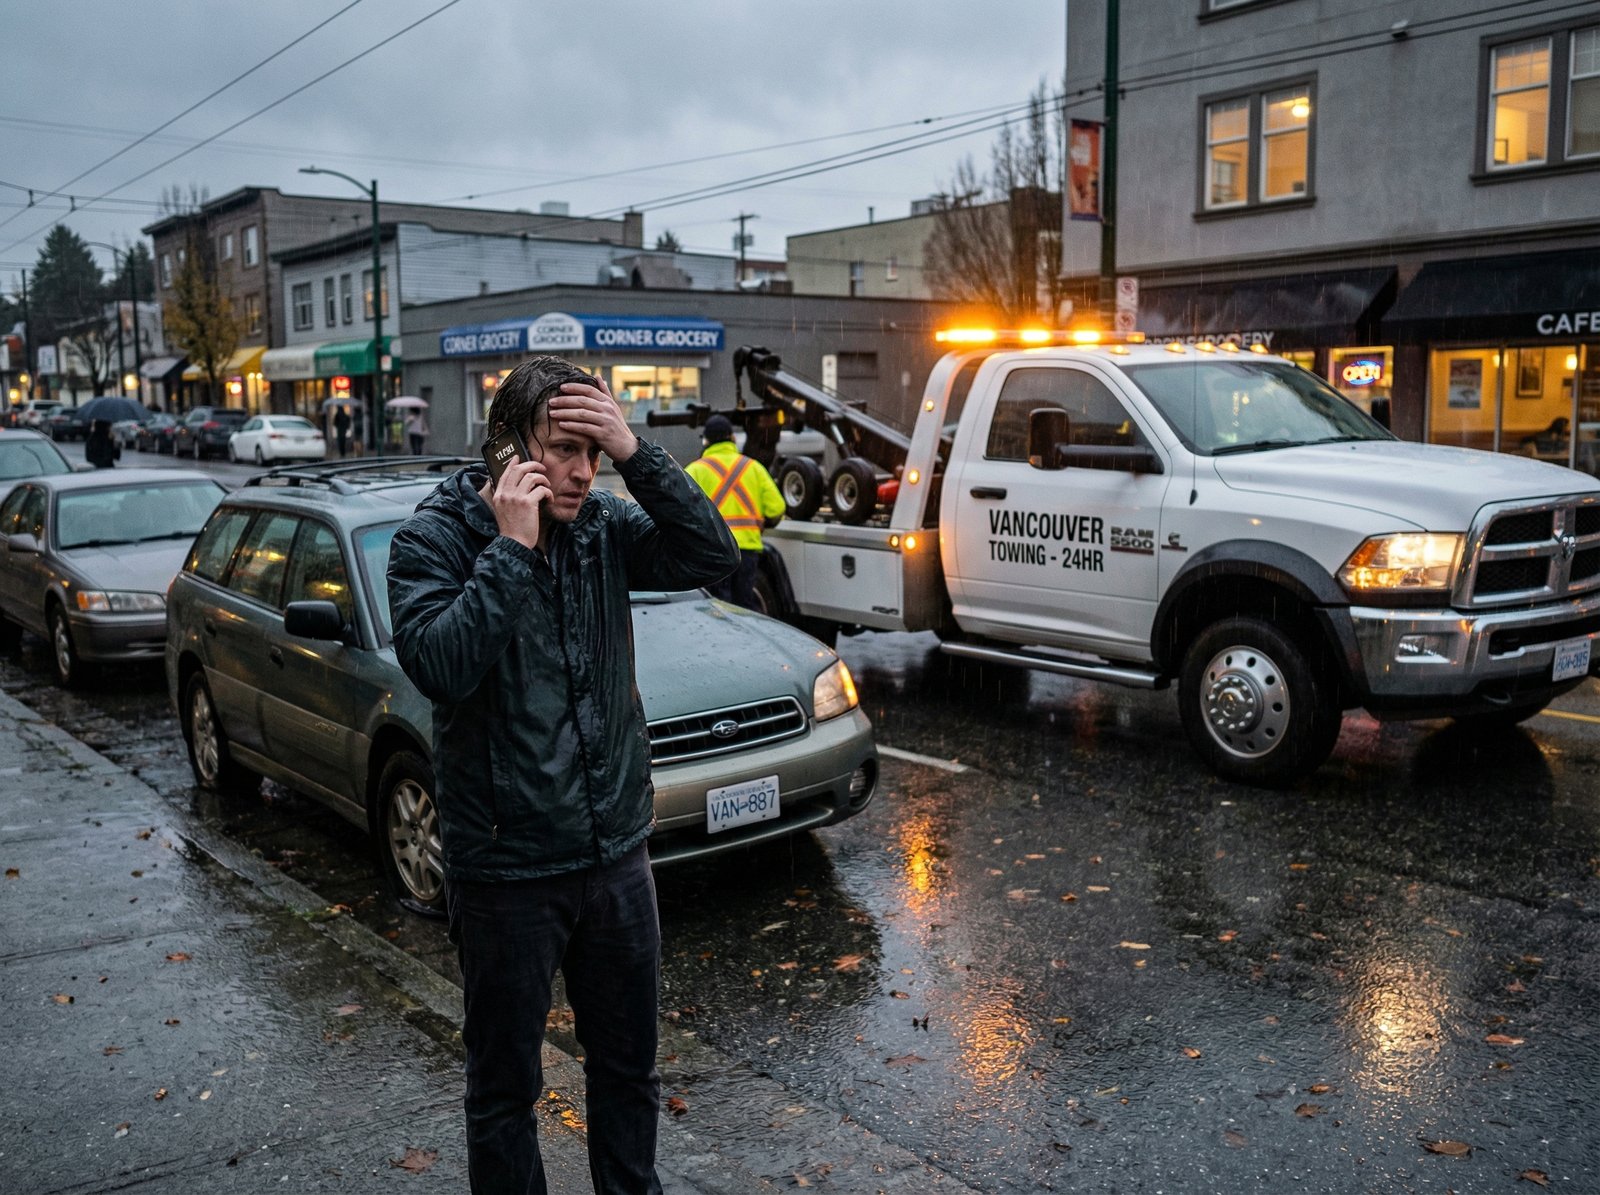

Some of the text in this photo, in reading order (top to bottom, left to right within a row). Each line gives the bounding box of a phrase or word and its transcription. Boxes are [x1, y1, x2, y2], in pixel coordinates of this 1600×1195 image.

[1536, 311, 1600, 335] CAFE
[595, 328, 719, 347] CORNER GROCERY
[1342, 365, 1381, 382] OPEN
[989, 509, 1104, 545] VANCOUVER
[1110, 526, 1154, 539] RAM
[1110, 536, 1154, 549] 5500
[989, 540, 1046, 566] TOWING
[1062, 547, 1104, 572] 24HR
